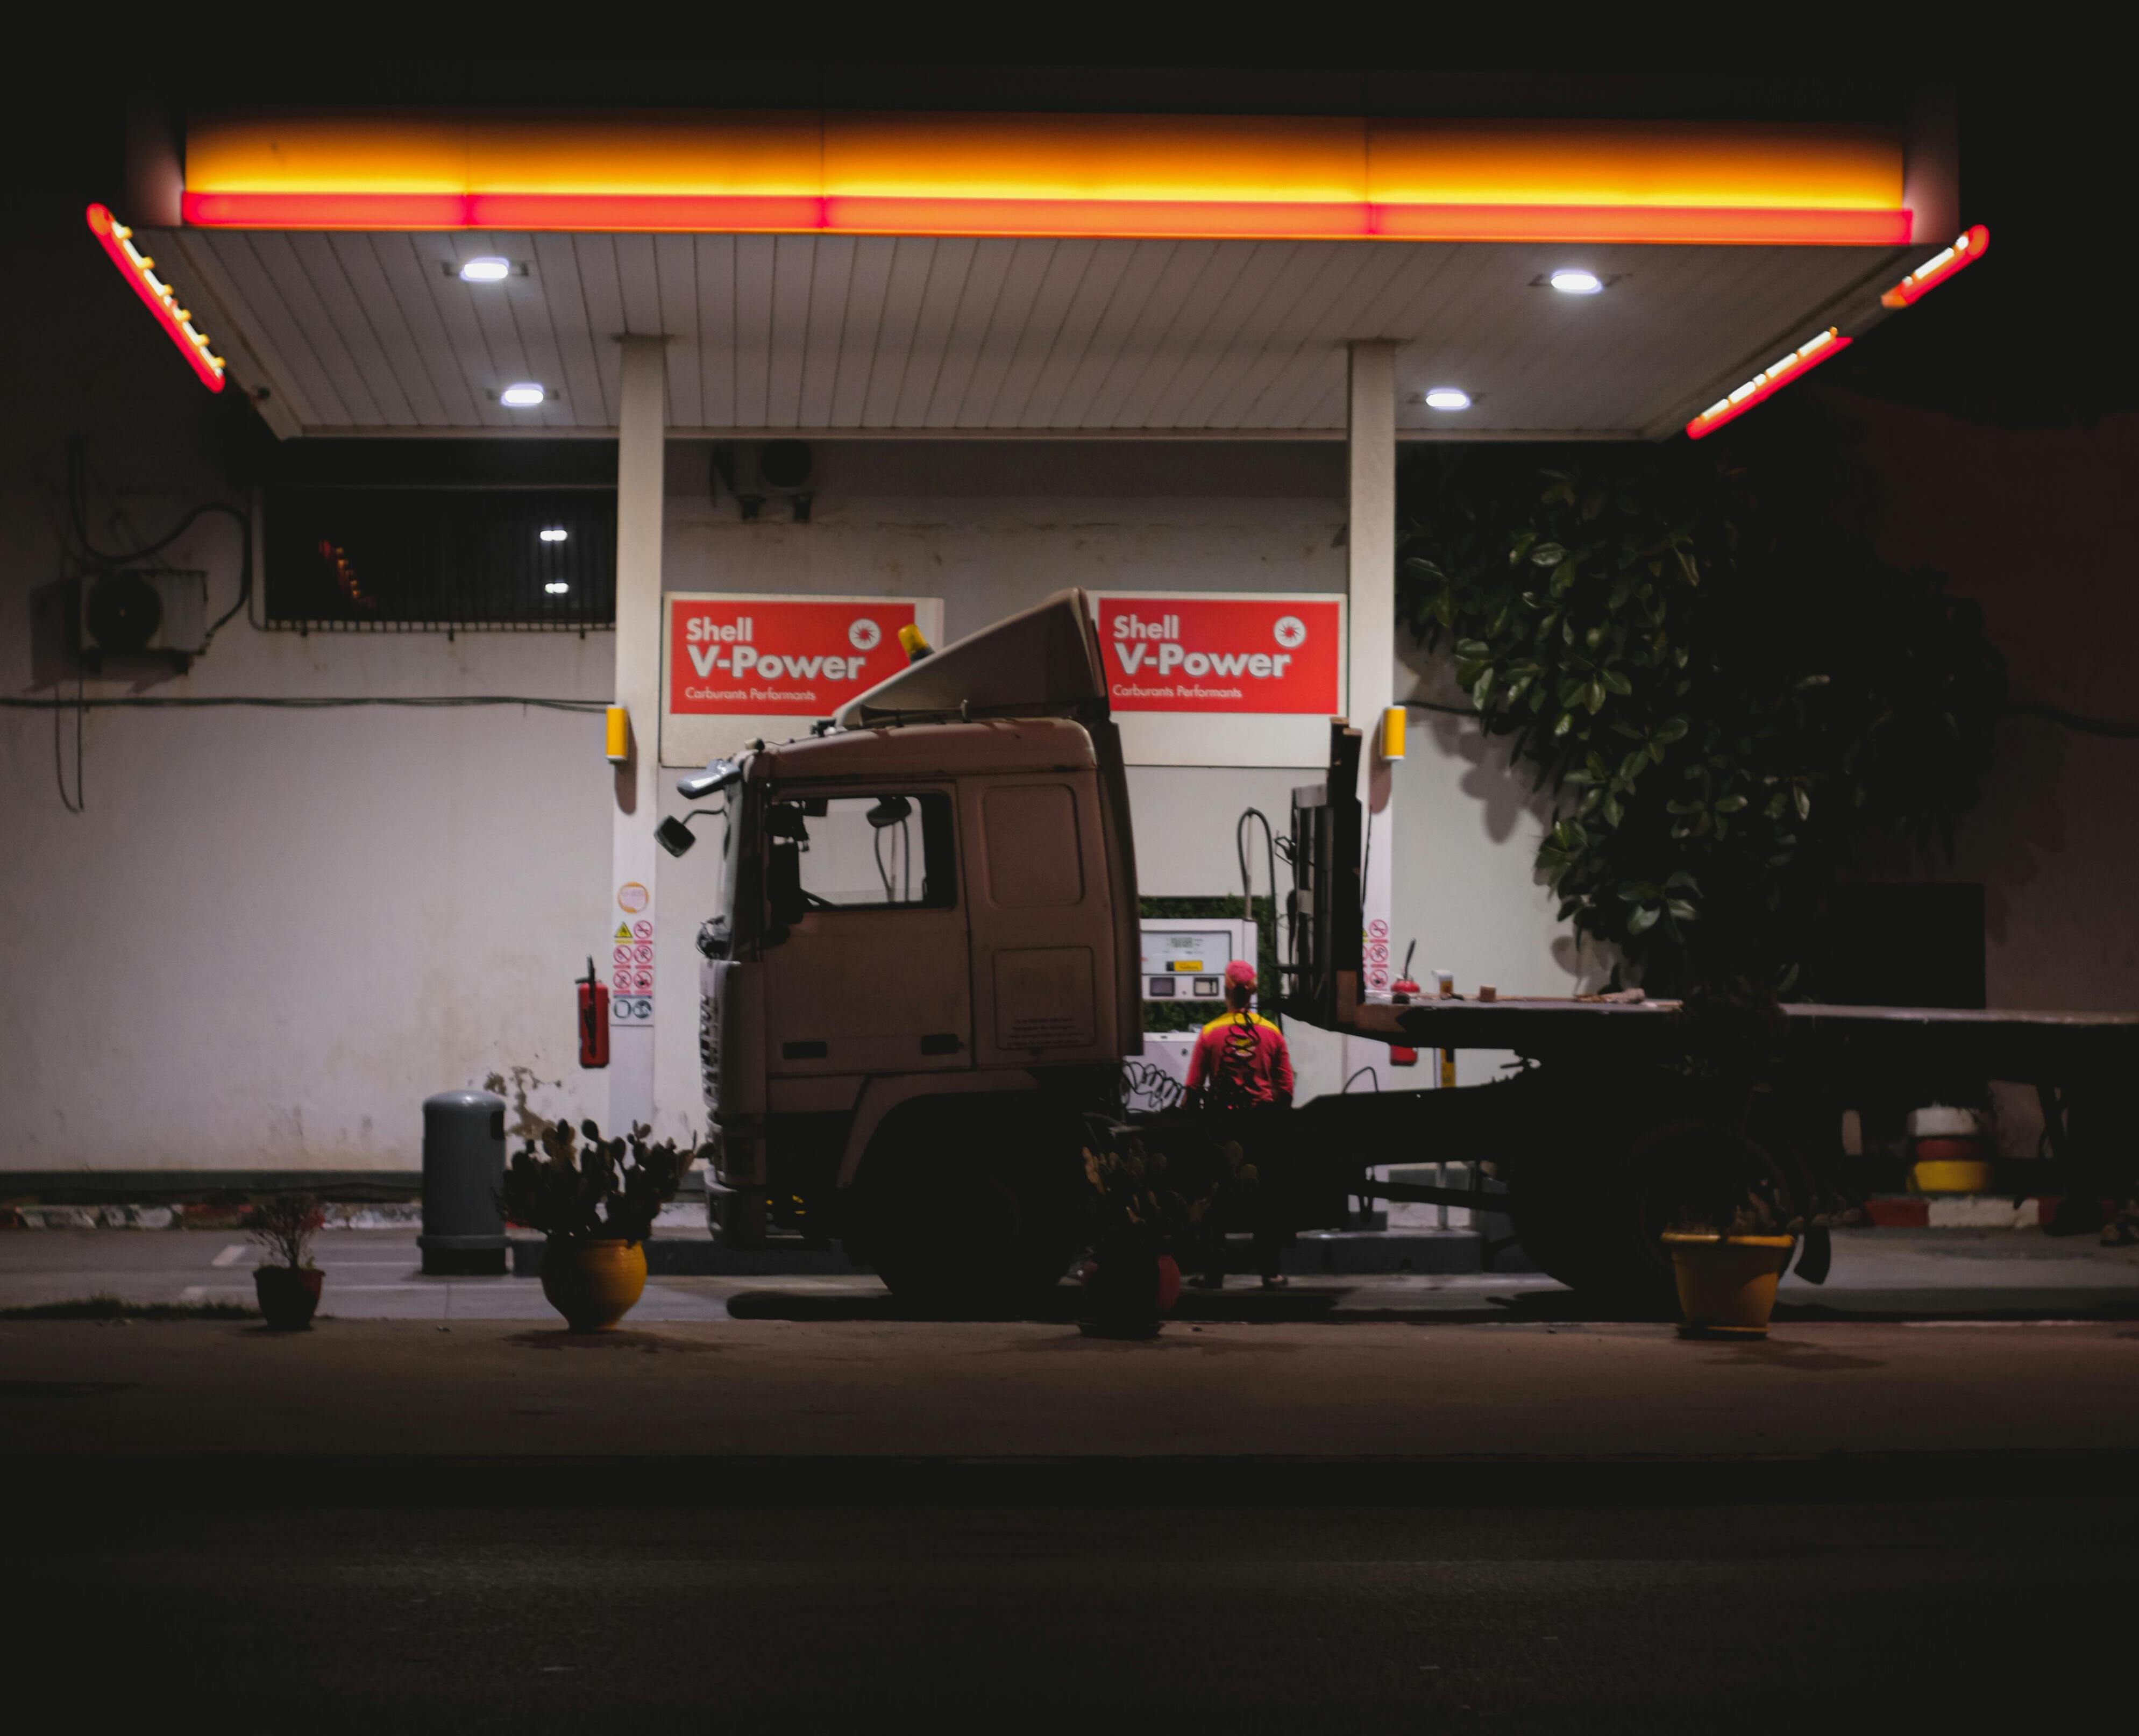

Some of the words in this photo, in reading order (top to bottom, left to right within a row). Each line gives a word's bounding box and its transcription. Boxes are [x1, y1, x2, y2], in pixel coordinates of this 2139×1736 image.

[686, 616, 753, 642] Shell
[1113, 614, 1179, 639] Shell
[686, 645, 866, 680] V-Power
[1114, 643, 1291, 678] V-Power
[685, 686, 747, 700] Carburants
[750, 687, 816, 701] Performants
[1112, 684, 1174, 698] Carburants
[1177, 685, 1242, 699] Performants
